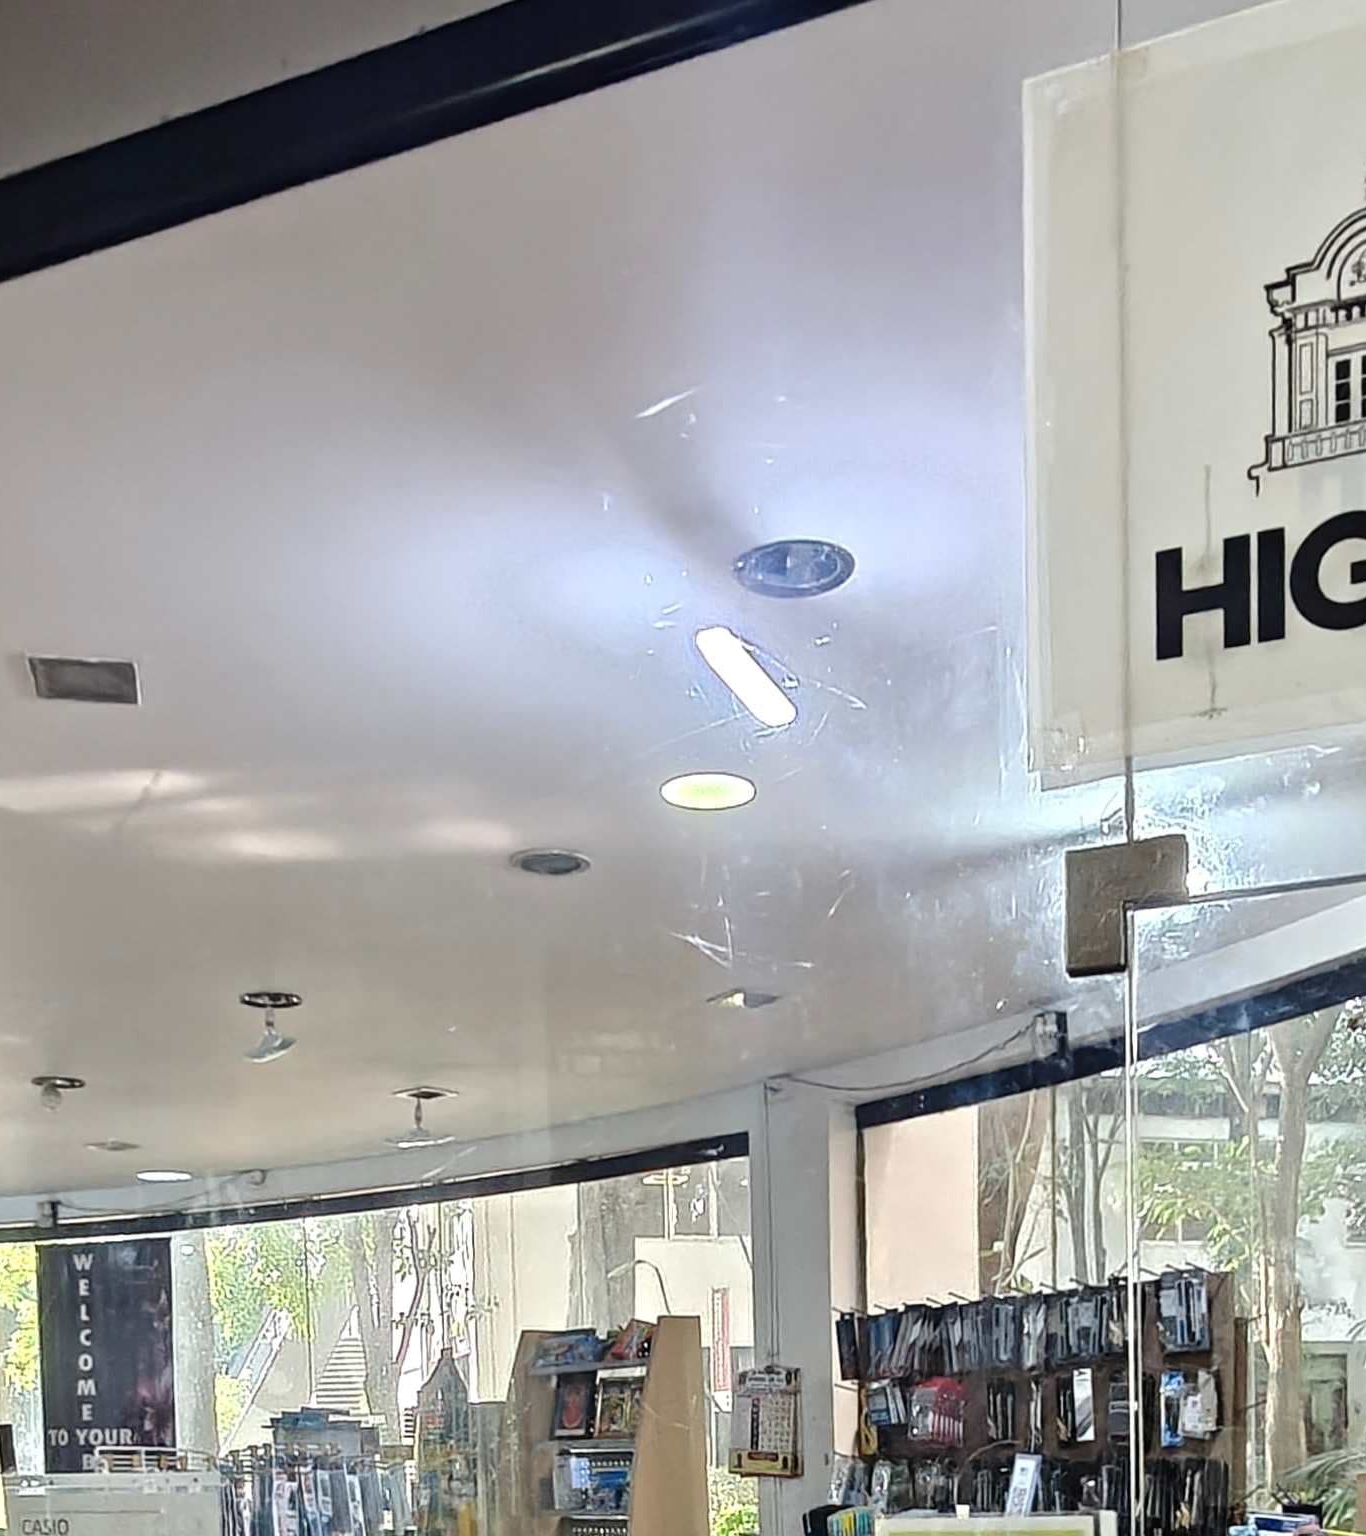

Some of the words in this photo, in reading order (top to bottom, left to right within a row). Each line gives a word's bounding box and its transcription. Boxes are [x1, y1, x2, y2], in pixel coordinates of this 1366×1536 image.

[72, 1253, 96, 1421] WELCOME
[48, 1429, 68, 1446] TO
[76, 1429, 134, 1446] YOUR
[22, 1519, 69, 1536] CASIO
